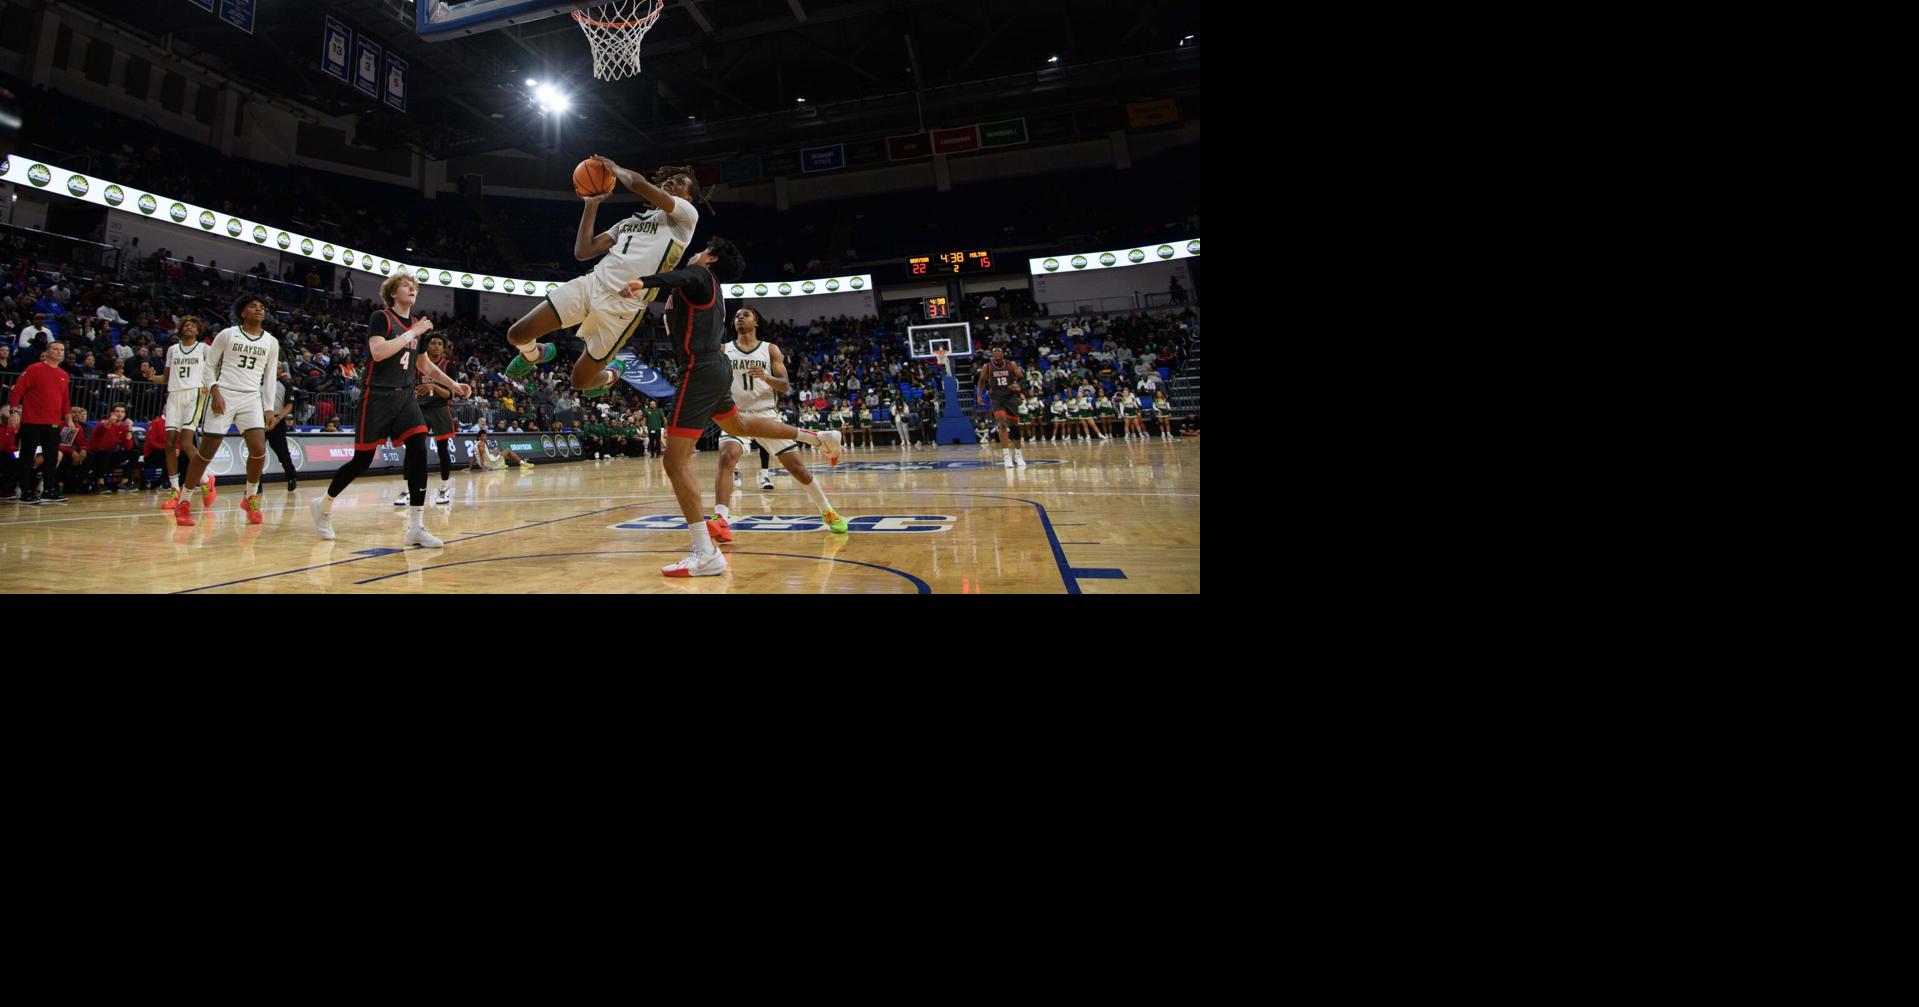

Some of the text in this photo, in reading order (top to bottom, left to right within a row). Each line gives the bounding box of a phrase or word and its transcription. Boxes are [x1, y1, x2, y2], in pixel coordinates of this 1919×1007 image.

[333, 43, 343, 56] 13
[365, 62, 371, 72] 3
[622, 235, 633, 254] 1
[940, 252, 964, 264] 4:38
[980, 257, 991, 268] 15
[912, 263, 926, 274] 22
[953, 265, 959, 273] 2
[929, 305, 946, 317] 31
[232, 343, 266, 356] GRAYSON
[174, 357, 199, 365] GRAYSON
[237, 355, 256, 370] 33
[399, 351, 411, 371] 4
[730, 359, 767, 371] RAYSON
[179, 367, 190, 378] 21
[742, 373, 754, 391] 11
[996, 377, 1008, 387] 12
[328, 448, 356, 457] MILTO
